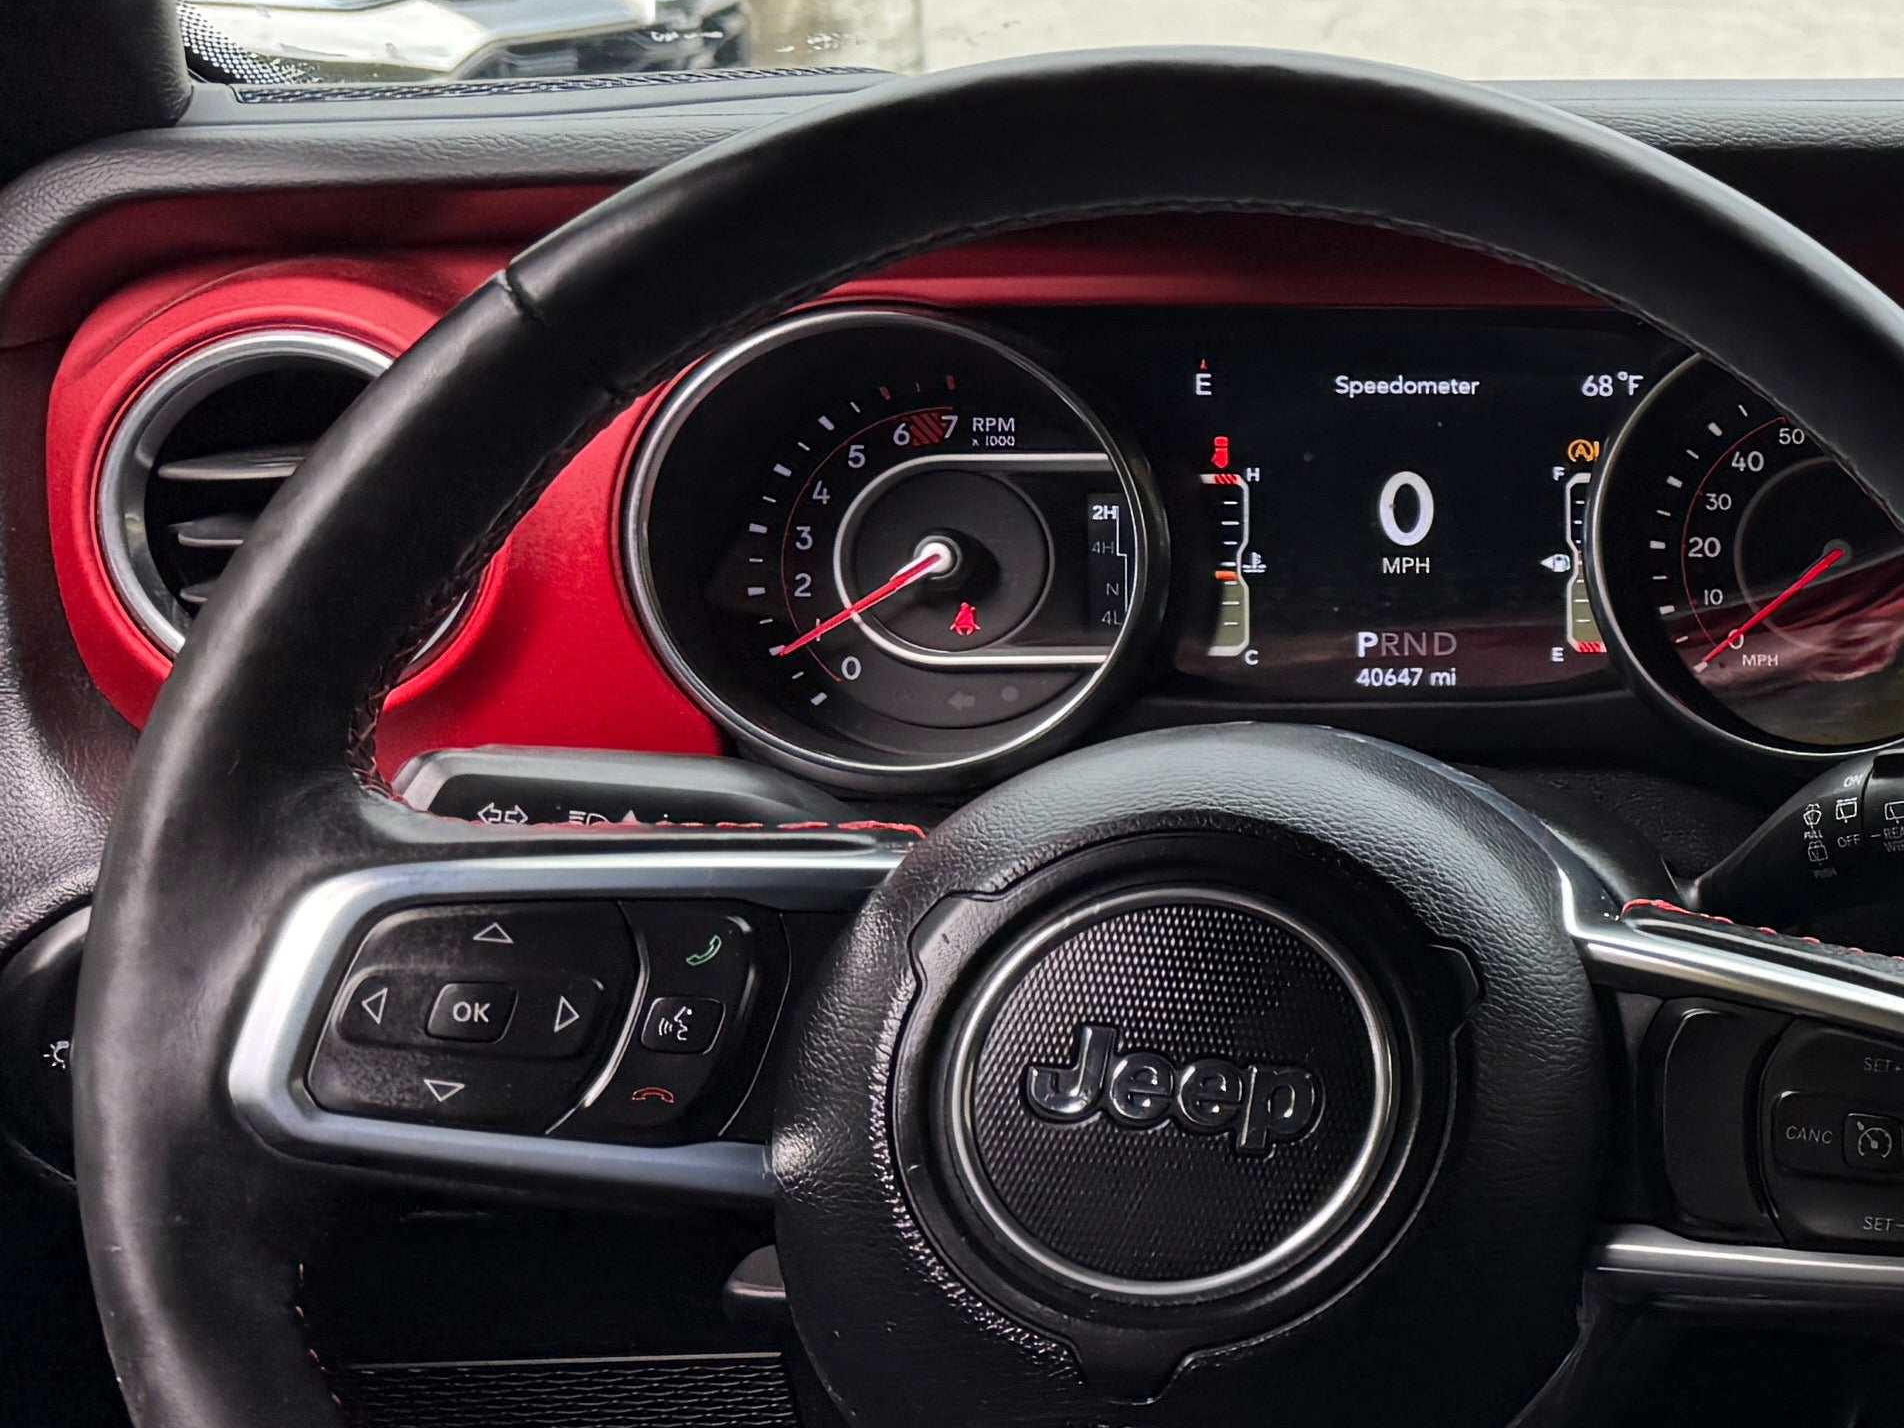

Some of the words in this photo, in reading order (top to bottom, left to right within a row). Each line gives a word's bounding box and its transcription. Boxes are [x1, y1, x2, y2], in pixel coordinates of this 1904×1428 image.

[1196, 373, 1212, 396] E
[1334, 374, 1481, 398] Speedometer
[892, 422, 911, 446] 6
[941, 414, 959, 440] 7
[972, 416, 1016, 432] RPM
[1778, 428, 1806, 446] 50
[847, 445, 866, 468] 5
[1730, 451, 1765, 472] 40
[1246, 468, 1260, 483] H
[1552, 466, 1565, 481] F
[812, 482, 831, 504] 4
[1705, 493, 1733, 512] 30
[1092, 505, 1119, 520] 2H
[1379, 471, 1435, 546] 0
[795, 526, 813, 550] 3
[1092, 540, 1115, 554] 4H
[1688, 536, 1722, 558] 20
[1382, 557, 1431, 575] MPH
[794, 573, 812, 597] 2
[1106, 582, 1120, 596] N
[1703, 588, 1724, 606] 10
[1244, 649, 1259, 666] C
[1551, 647, 1565, 662] E
[1741, 653, 1780, 667] MPH
[841, 656, 862, 679] 0
[1356, 668, 1424, 687] 40647
[1429, 667, 1457, 687] mi
[1842, 774, 1864, 788] ON
[1836, 833, 1861, 849] OFF
[452, 1002, 490, 1024] OK
[1026, 1024, 1326, 1156] Jeep
[1785, 1124, 1833, 1146] CANC
